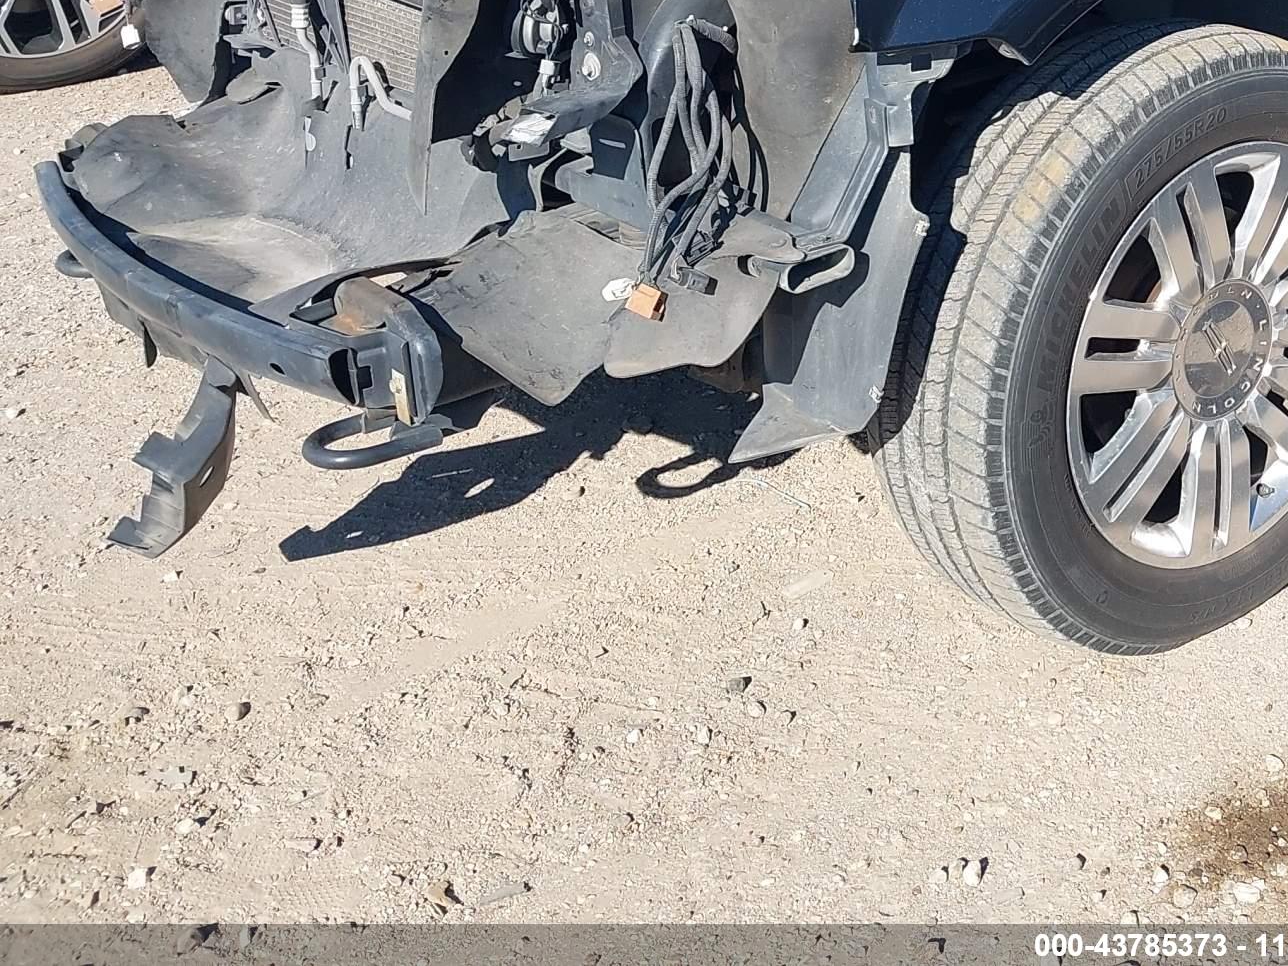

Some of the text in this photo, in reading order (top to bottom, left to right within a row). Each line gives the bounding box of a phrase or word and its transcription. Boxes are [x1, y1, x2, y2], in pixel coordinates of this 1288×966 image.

[1134, 105, 1227, 183] 275/55R20
[1037, 195, 1124, 392] MICHELIN
[1192, 318, 1268, 414] LINCOLN
